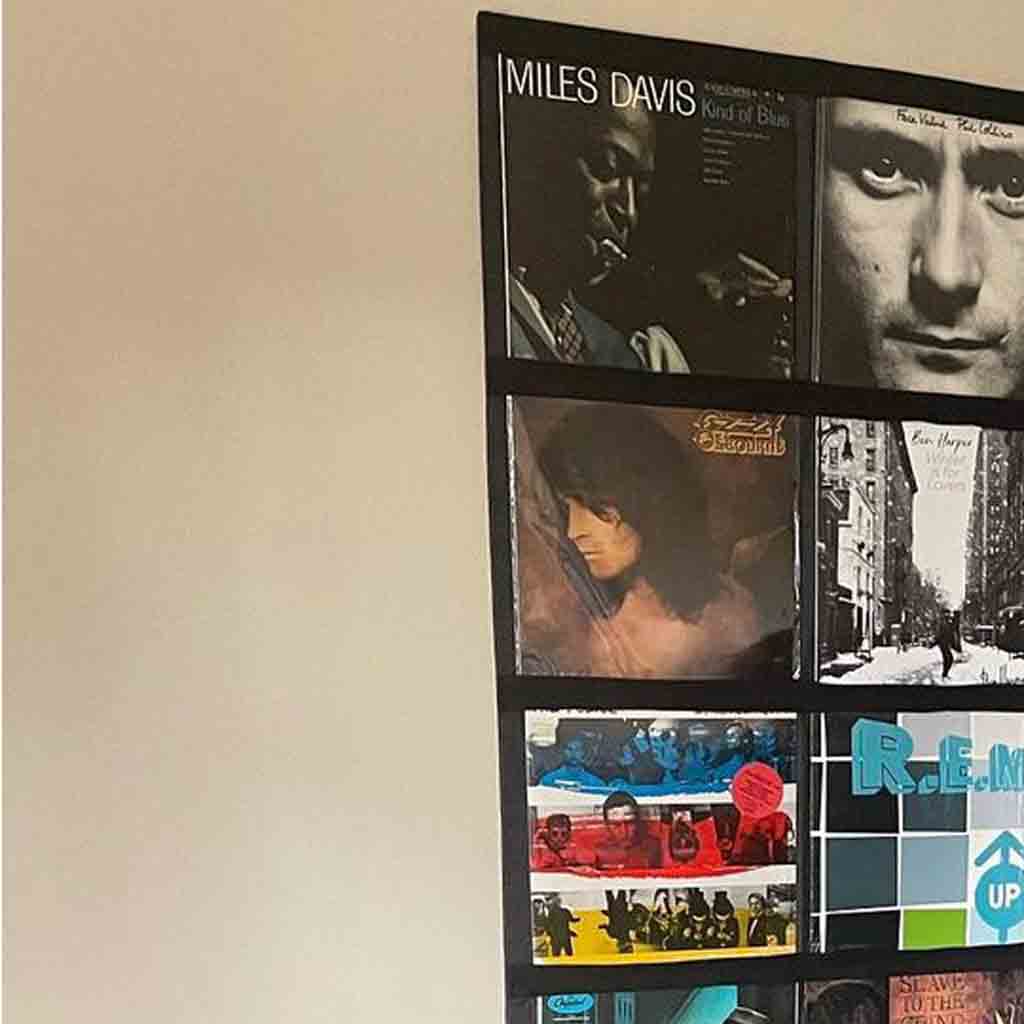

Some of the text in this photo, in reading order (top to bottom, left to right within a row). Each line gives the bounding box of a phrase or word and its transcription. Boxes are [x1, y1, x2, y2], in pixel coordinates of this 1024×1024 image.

[506, 57, 598, 105] MILES
[610, 71, 696, 117] DAVIS
[987, 882, 1021, 909] UP
[899, 993, 965, 1013] TO THE
